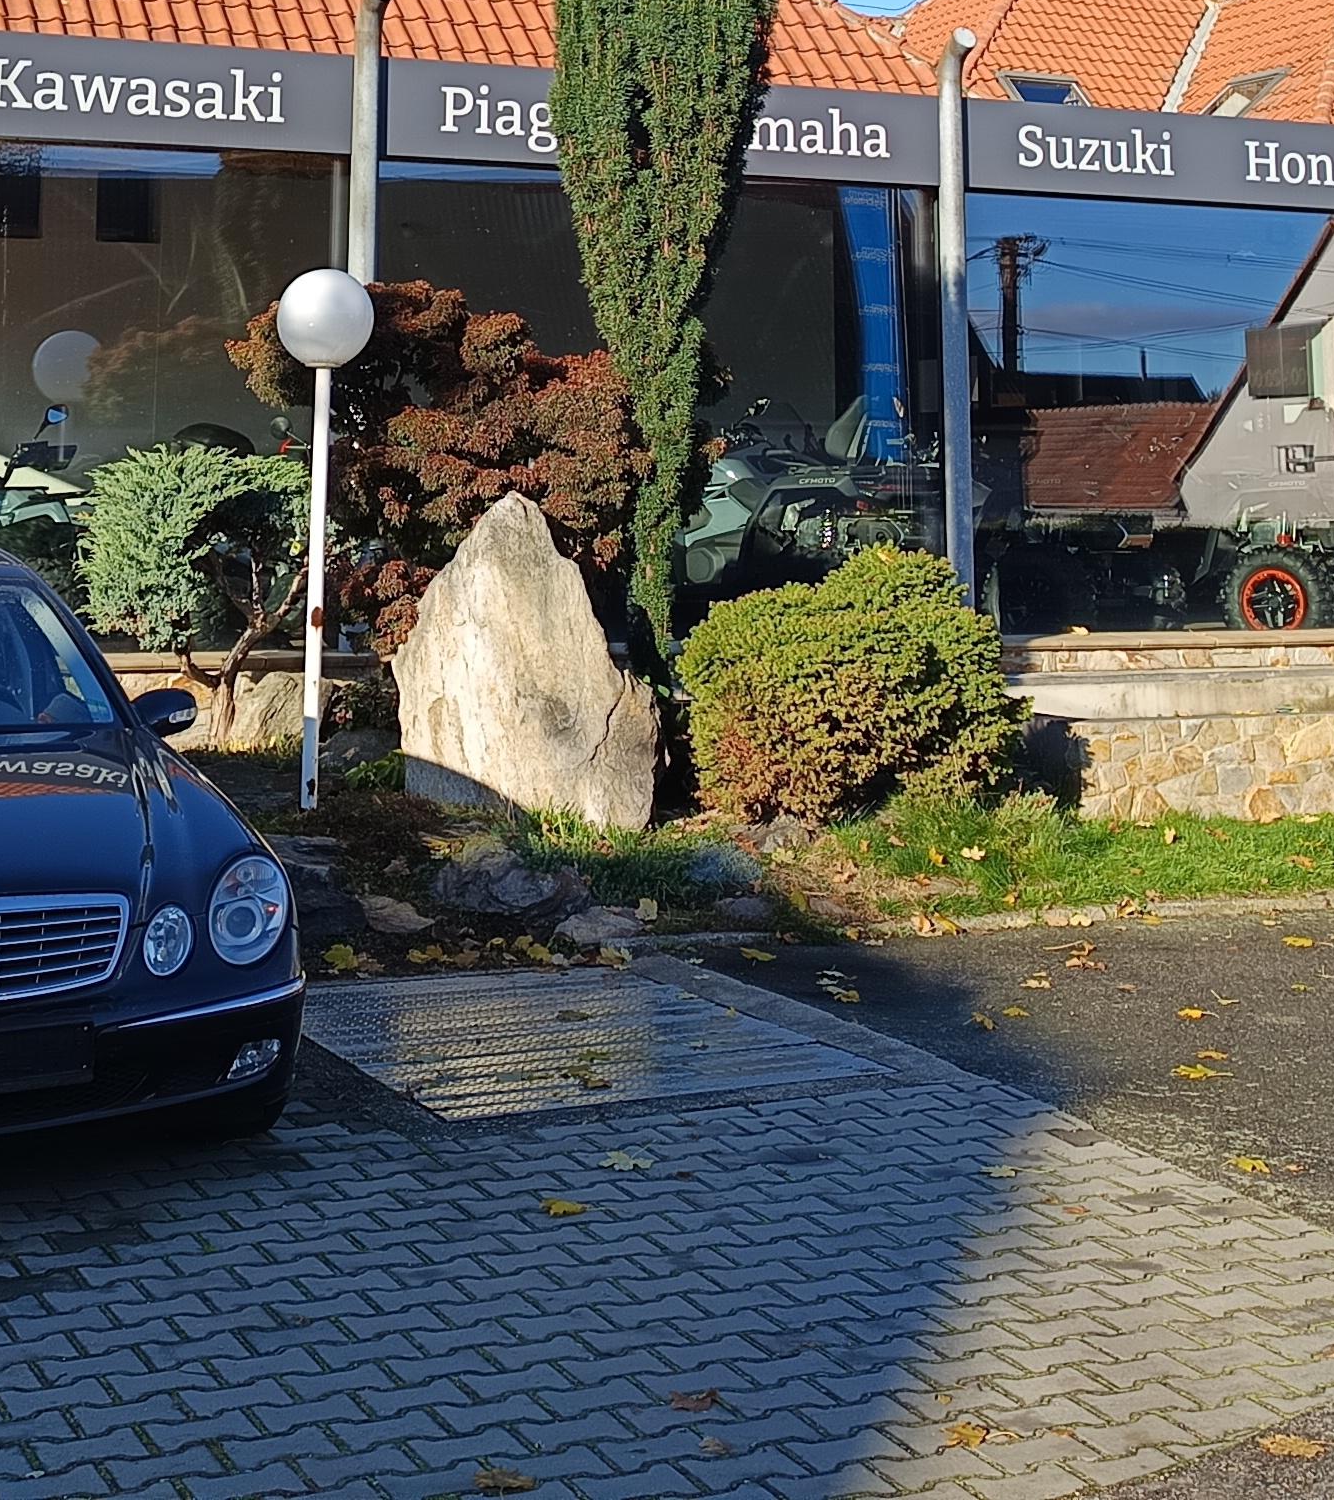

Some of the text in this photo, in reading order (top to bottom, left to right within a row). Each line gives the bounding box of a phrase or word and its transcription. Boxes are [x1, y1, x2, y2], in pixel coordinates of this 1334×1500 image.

[439, 83, 892, 159] Piag maha
[1017, 123, 1176, 177] Suzuki
[798, 477, 835, 485] CFMOTO
